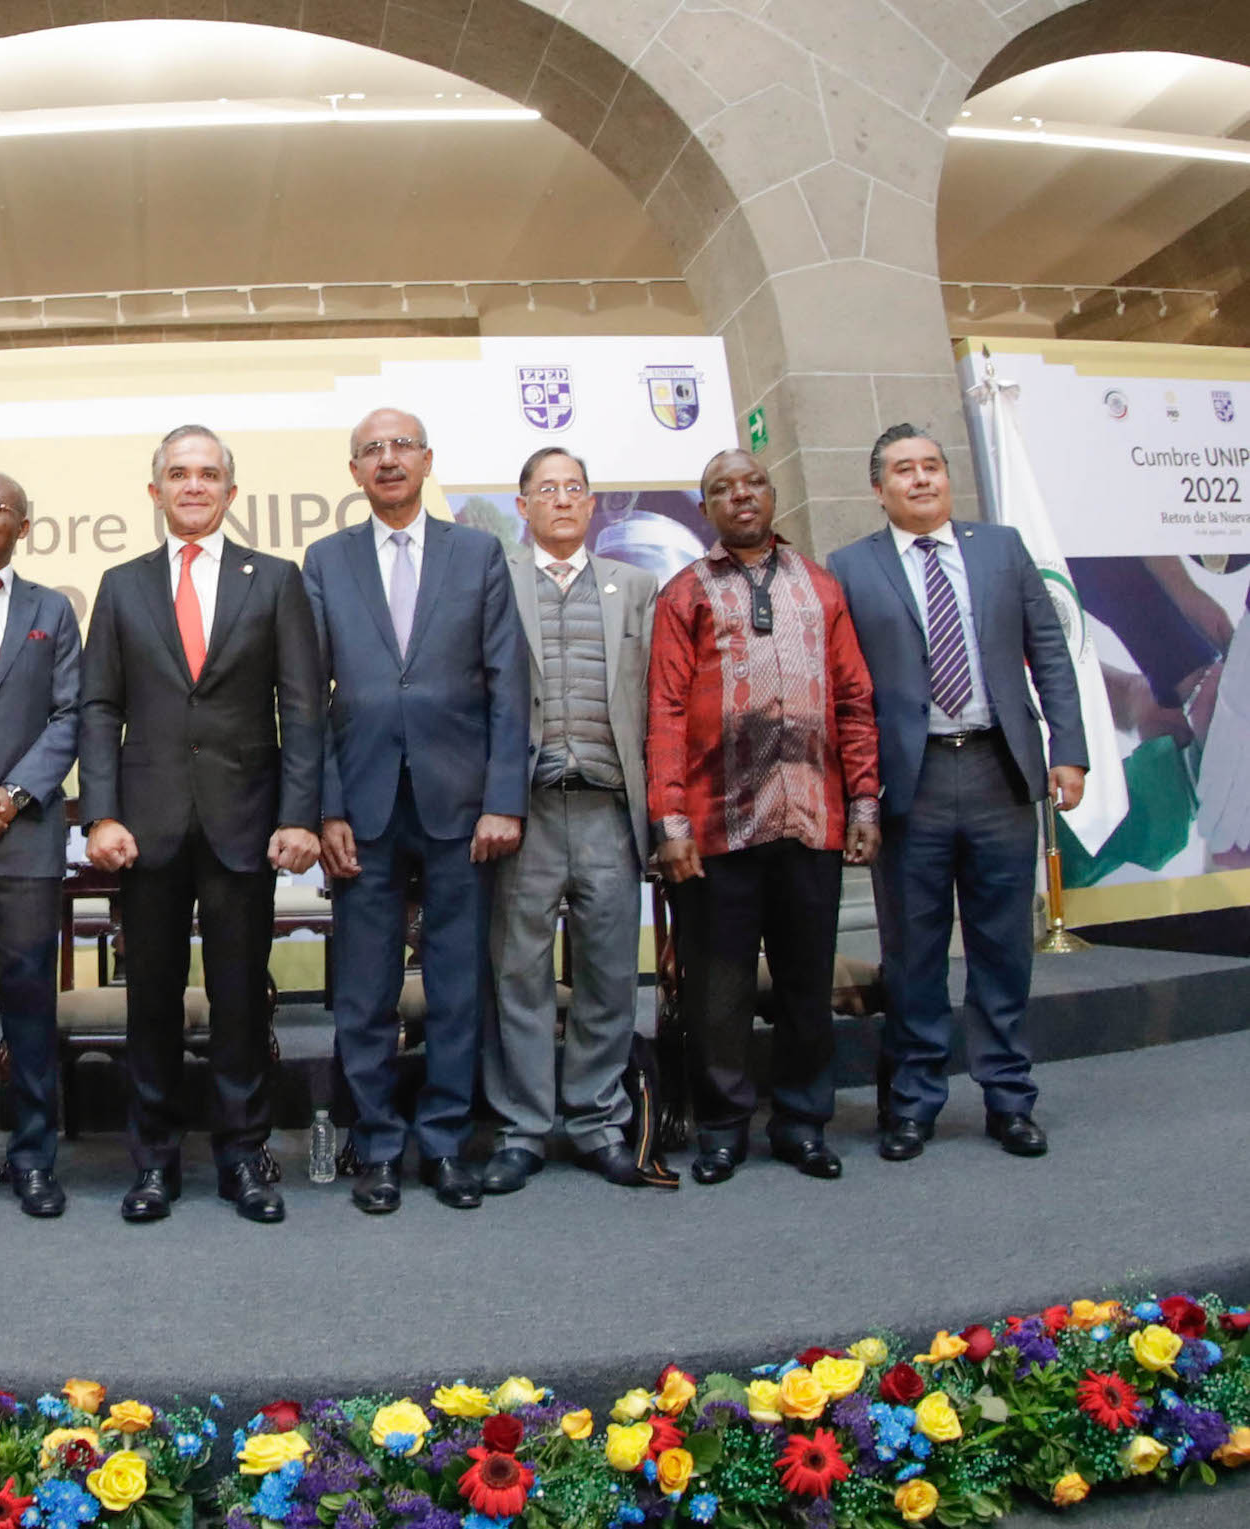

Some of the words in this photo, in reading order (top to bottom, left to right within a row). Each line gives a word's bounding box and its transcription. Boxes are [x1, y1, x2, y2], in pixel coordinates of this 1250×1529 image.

[522, 369, 568, 381] EPED
[1131, 446, 1201, 467] Cumbre
[1204, 446, 1250, 467] UNIP
[1181, 476, 1242, 503] 2022
[1161, 511, 1192, 524] Retos
[1193, 510, 1206, 524] de
[1207, 510, 1218, 523] la
